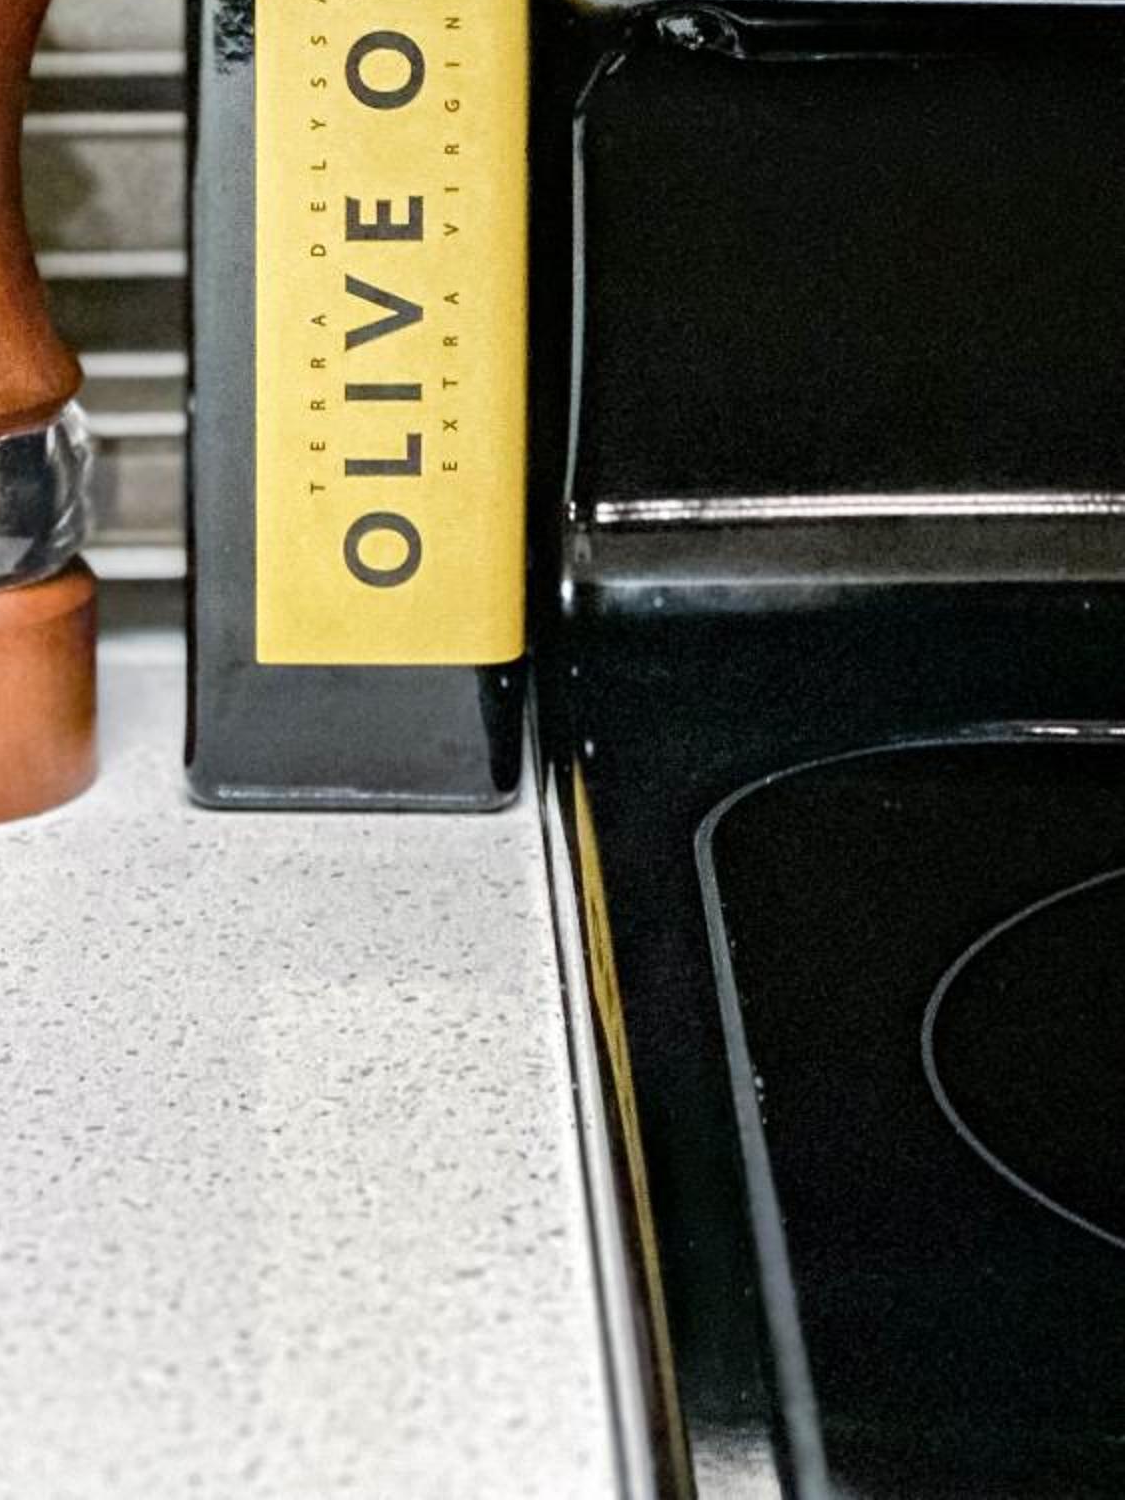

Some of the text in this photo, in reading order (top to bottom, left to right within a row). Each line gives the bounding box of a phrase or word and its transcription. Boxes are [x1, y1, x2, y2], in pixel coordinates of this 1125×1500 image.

[310, 314, 327, 494] TERRA
[343, 195, 424, 588] OLIVE
[442, 16, 461, 472] EXTRA VIRGIN
